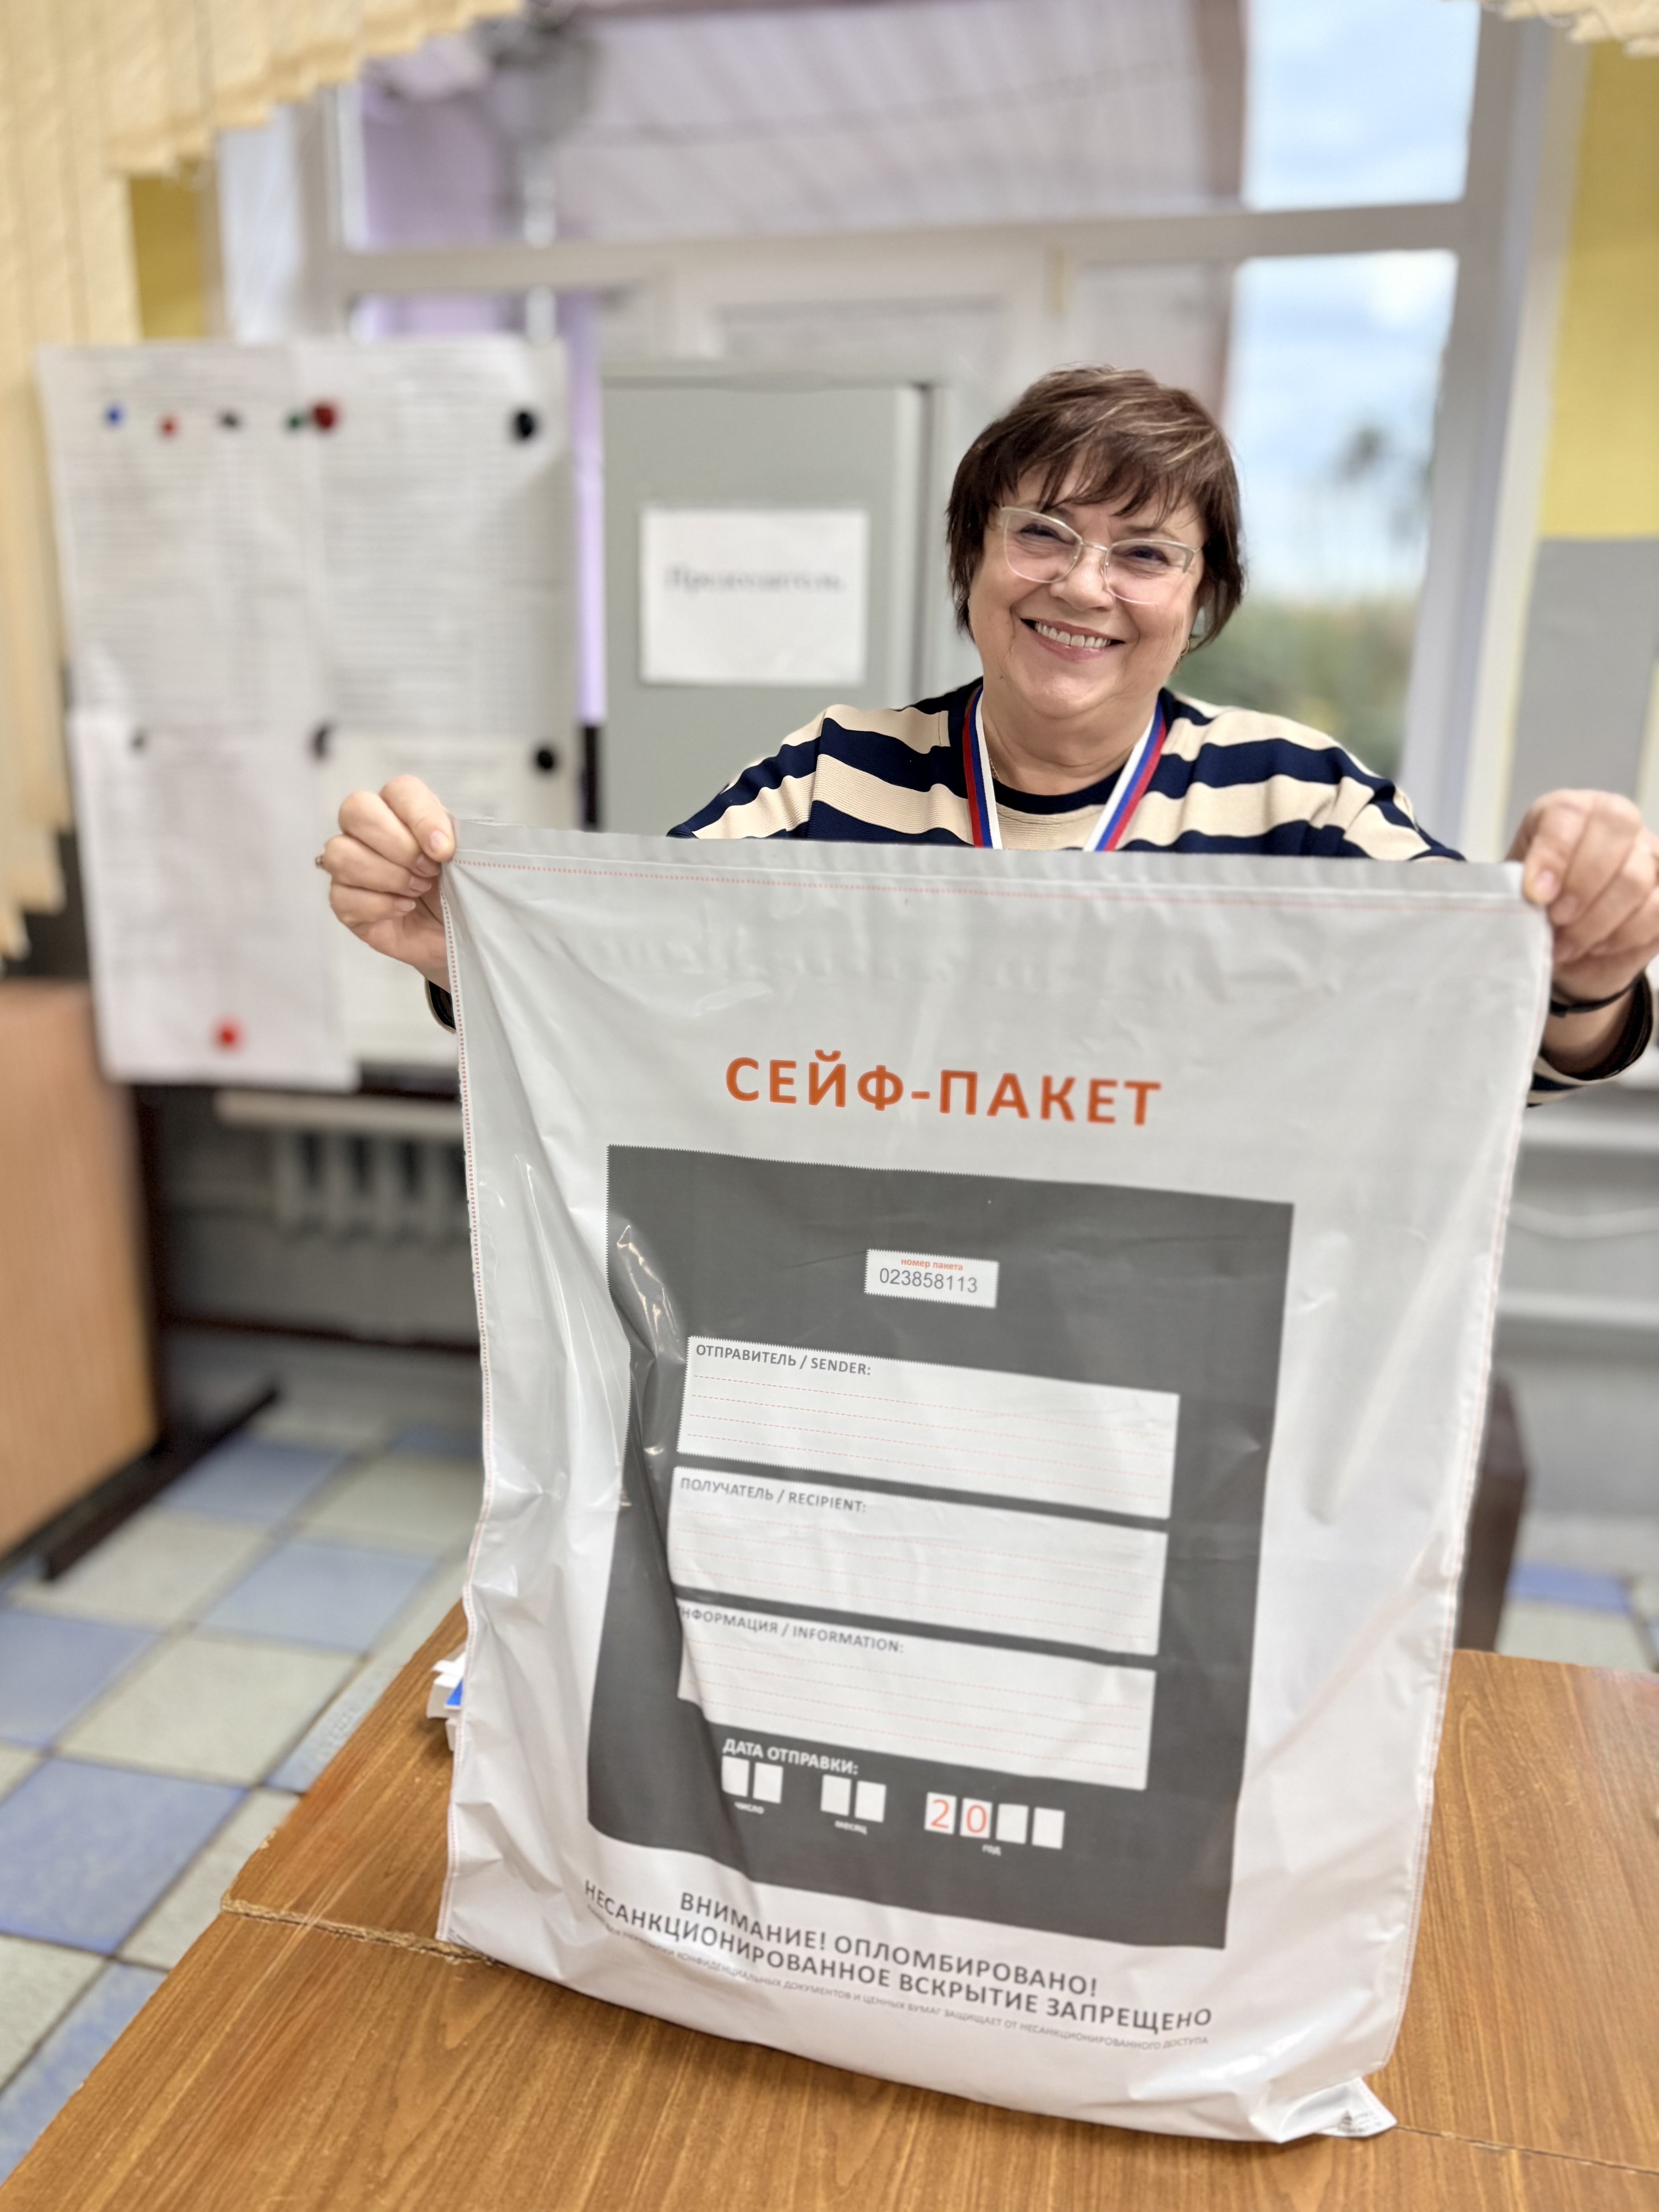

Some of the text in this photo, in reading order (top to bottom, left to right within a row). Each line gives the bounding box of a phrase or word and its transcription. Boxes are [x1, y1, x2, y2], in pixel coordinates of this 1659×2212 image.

[726, 1049, 1162, 1126] СЕЙФ-ПАКЕТ
[879, 1268, 977, 1293] 023858113
[901, 1259, 963, 1271] номер пакета
[696, 1344, 871, 1376] ОТПРАВИТЕЛЬ / SENDER:
[681, 1477, 866, 1513] ПОЛУЧАТЕЛЬ / RECIPIENT:
[678, 1606, 904, 1654] НФОРМАЦИЯ / INFORMATION:
[723, 1738, 858, 1775] ДАТА ОТПРАВКИ:
[585, 1880, 890, 1988] НЕСАНКЦИОНИРОВАННОЕ
[899, 1973, 1038, 2013] ВСКРЫТИЕ
[1046, 1997, 1211, 2035] ЗАПРЕЩЕНО
[680, 1892, 1097, 1997] ВНИМАНИЕ! ОПЛОМБИРОВАНО!
[783, 1981, 851, 1999] ДОКУМЕНТОВ
[853, 1994, 861, 2002] И
[862, 1995, 905, 2010] ЦЕННЫХ
[907, 2004, 942, 2016] БУМАГ
[944, 2009, 1002, 2026] ЗАЩИЩАЕТ
[1004, 2020, 1018, 2029] ОТ
[1019, 2022, 1161, 2050] НЕСАНКЦИОНИРОВАННОГО
[1163, 2036, 1209, 2050] ДОСТУПА
